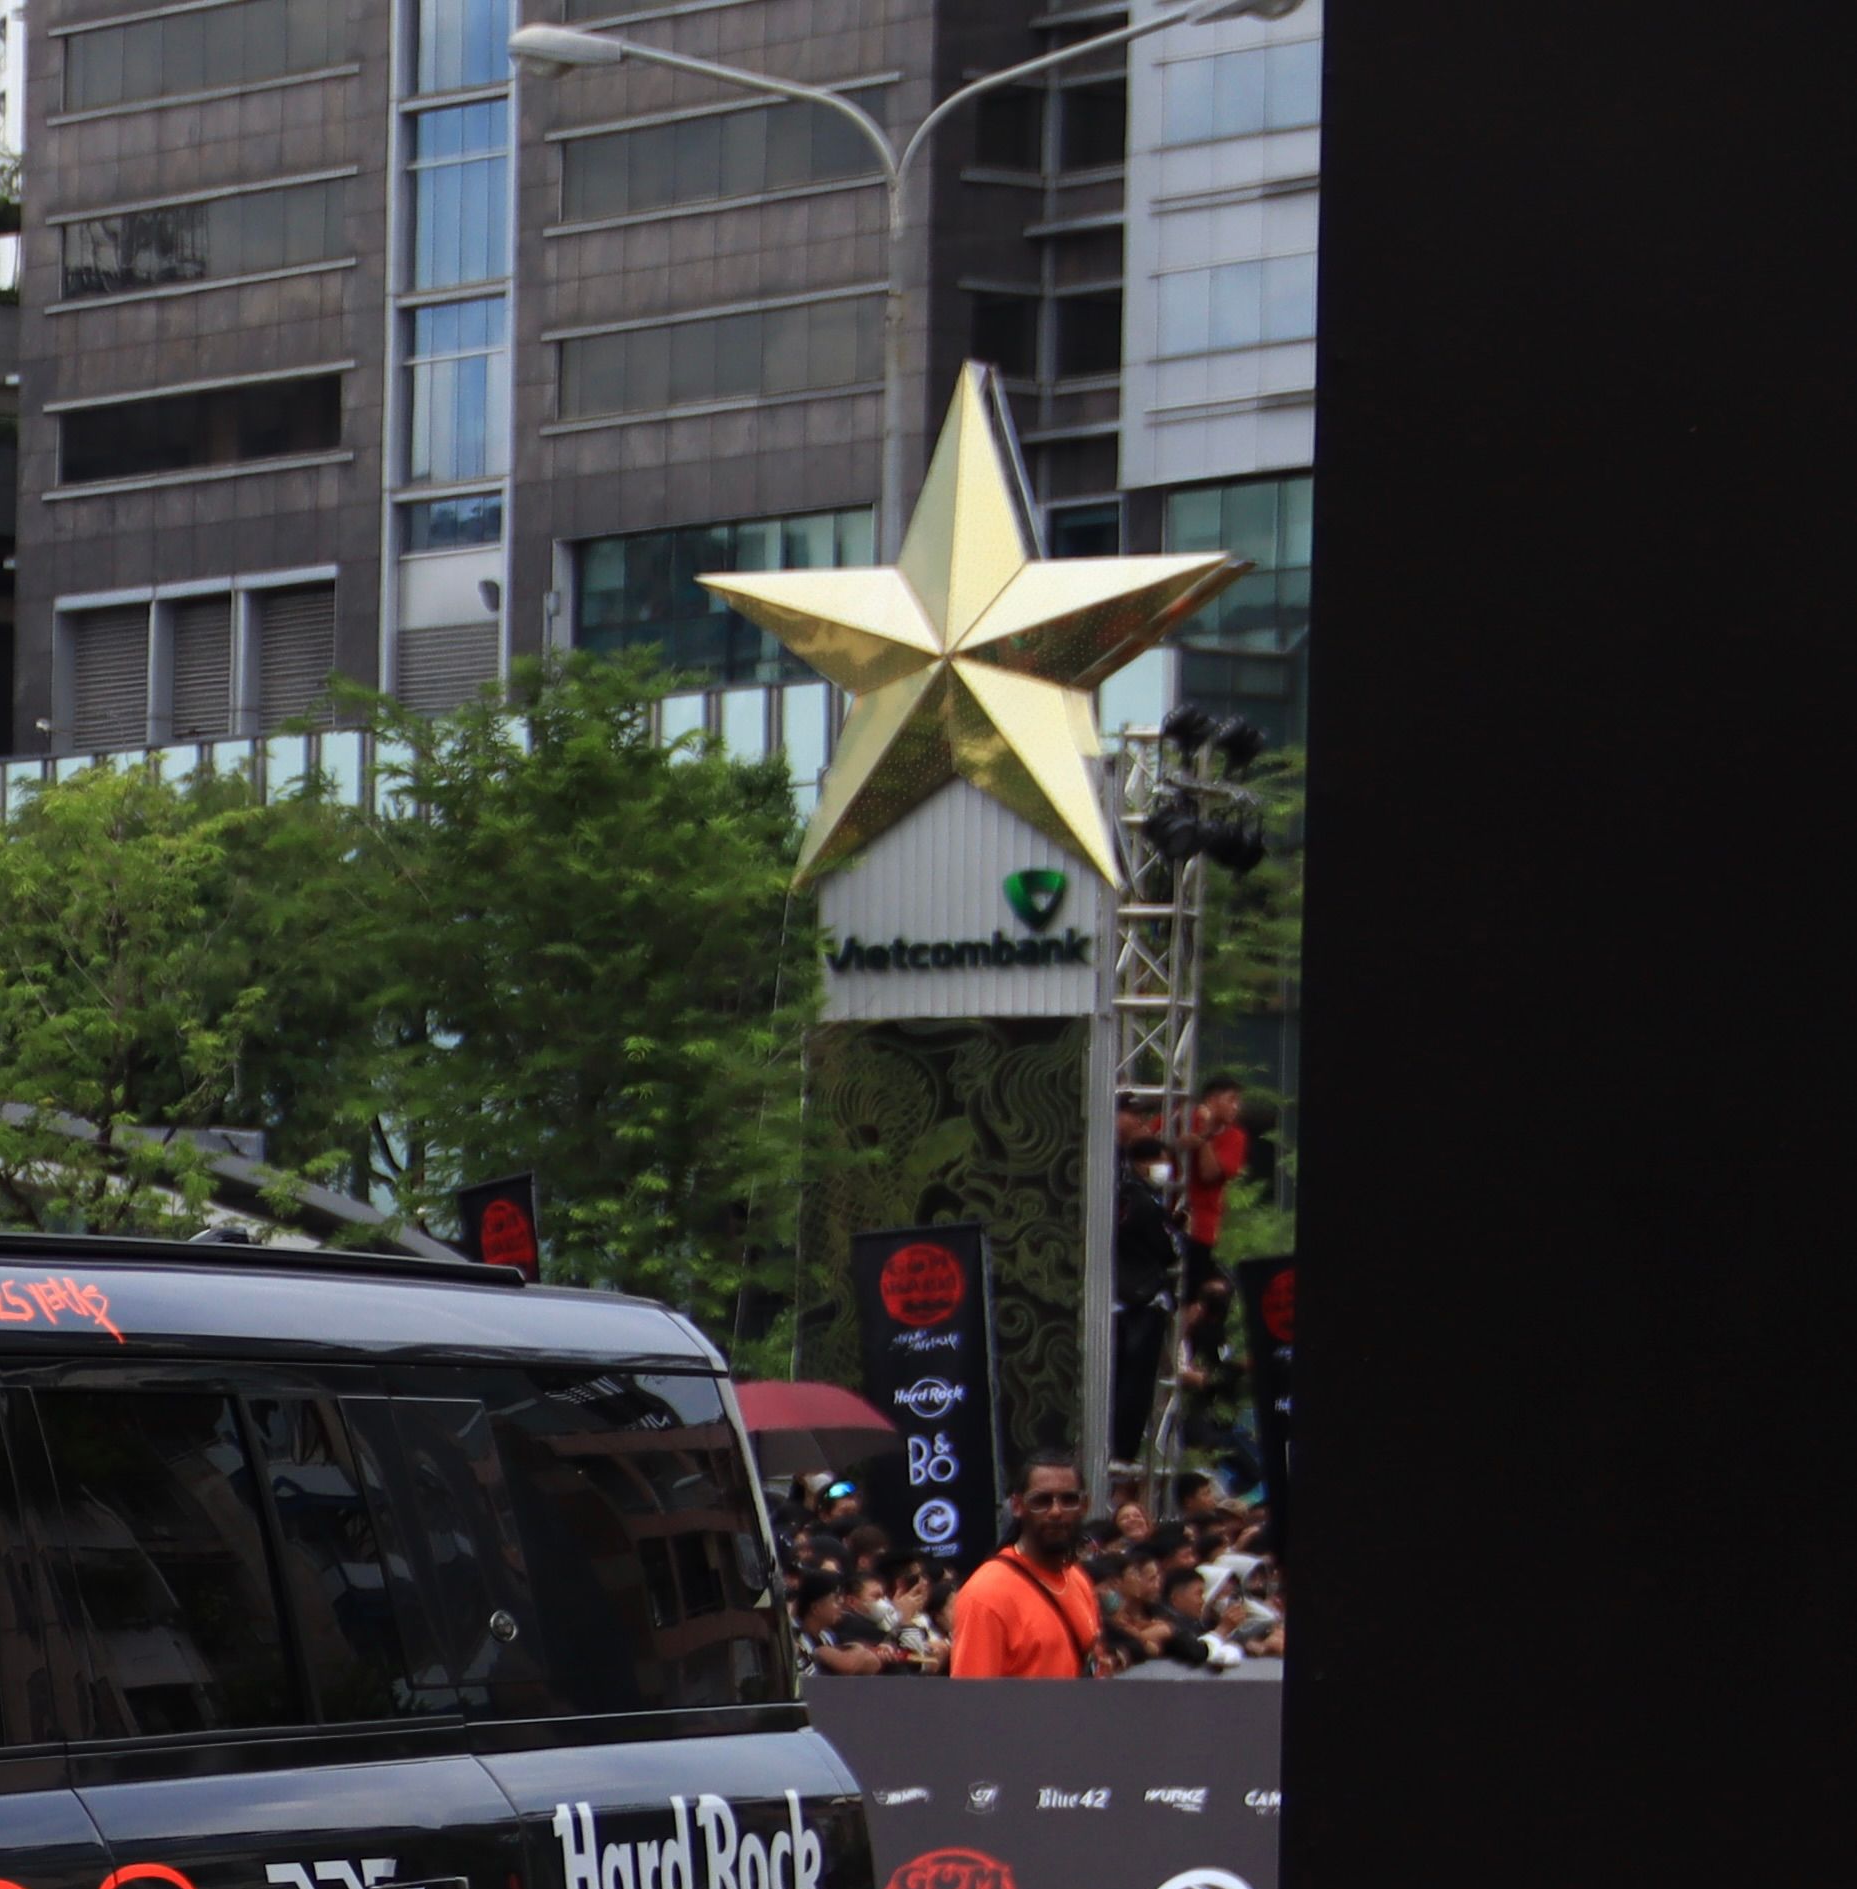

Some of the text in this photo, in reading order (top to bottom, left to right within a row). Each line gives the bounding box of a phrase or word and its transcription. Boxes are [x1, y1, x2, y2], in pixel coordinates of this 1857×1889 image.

[826, 927, 1091, 973] Vietcombank
[894, 1384, 964, 1406] Hard Rock
[1036, 1787, 1110, 1809] Blue 42
[1144, 1787, 1206, 1803] WURKZ
